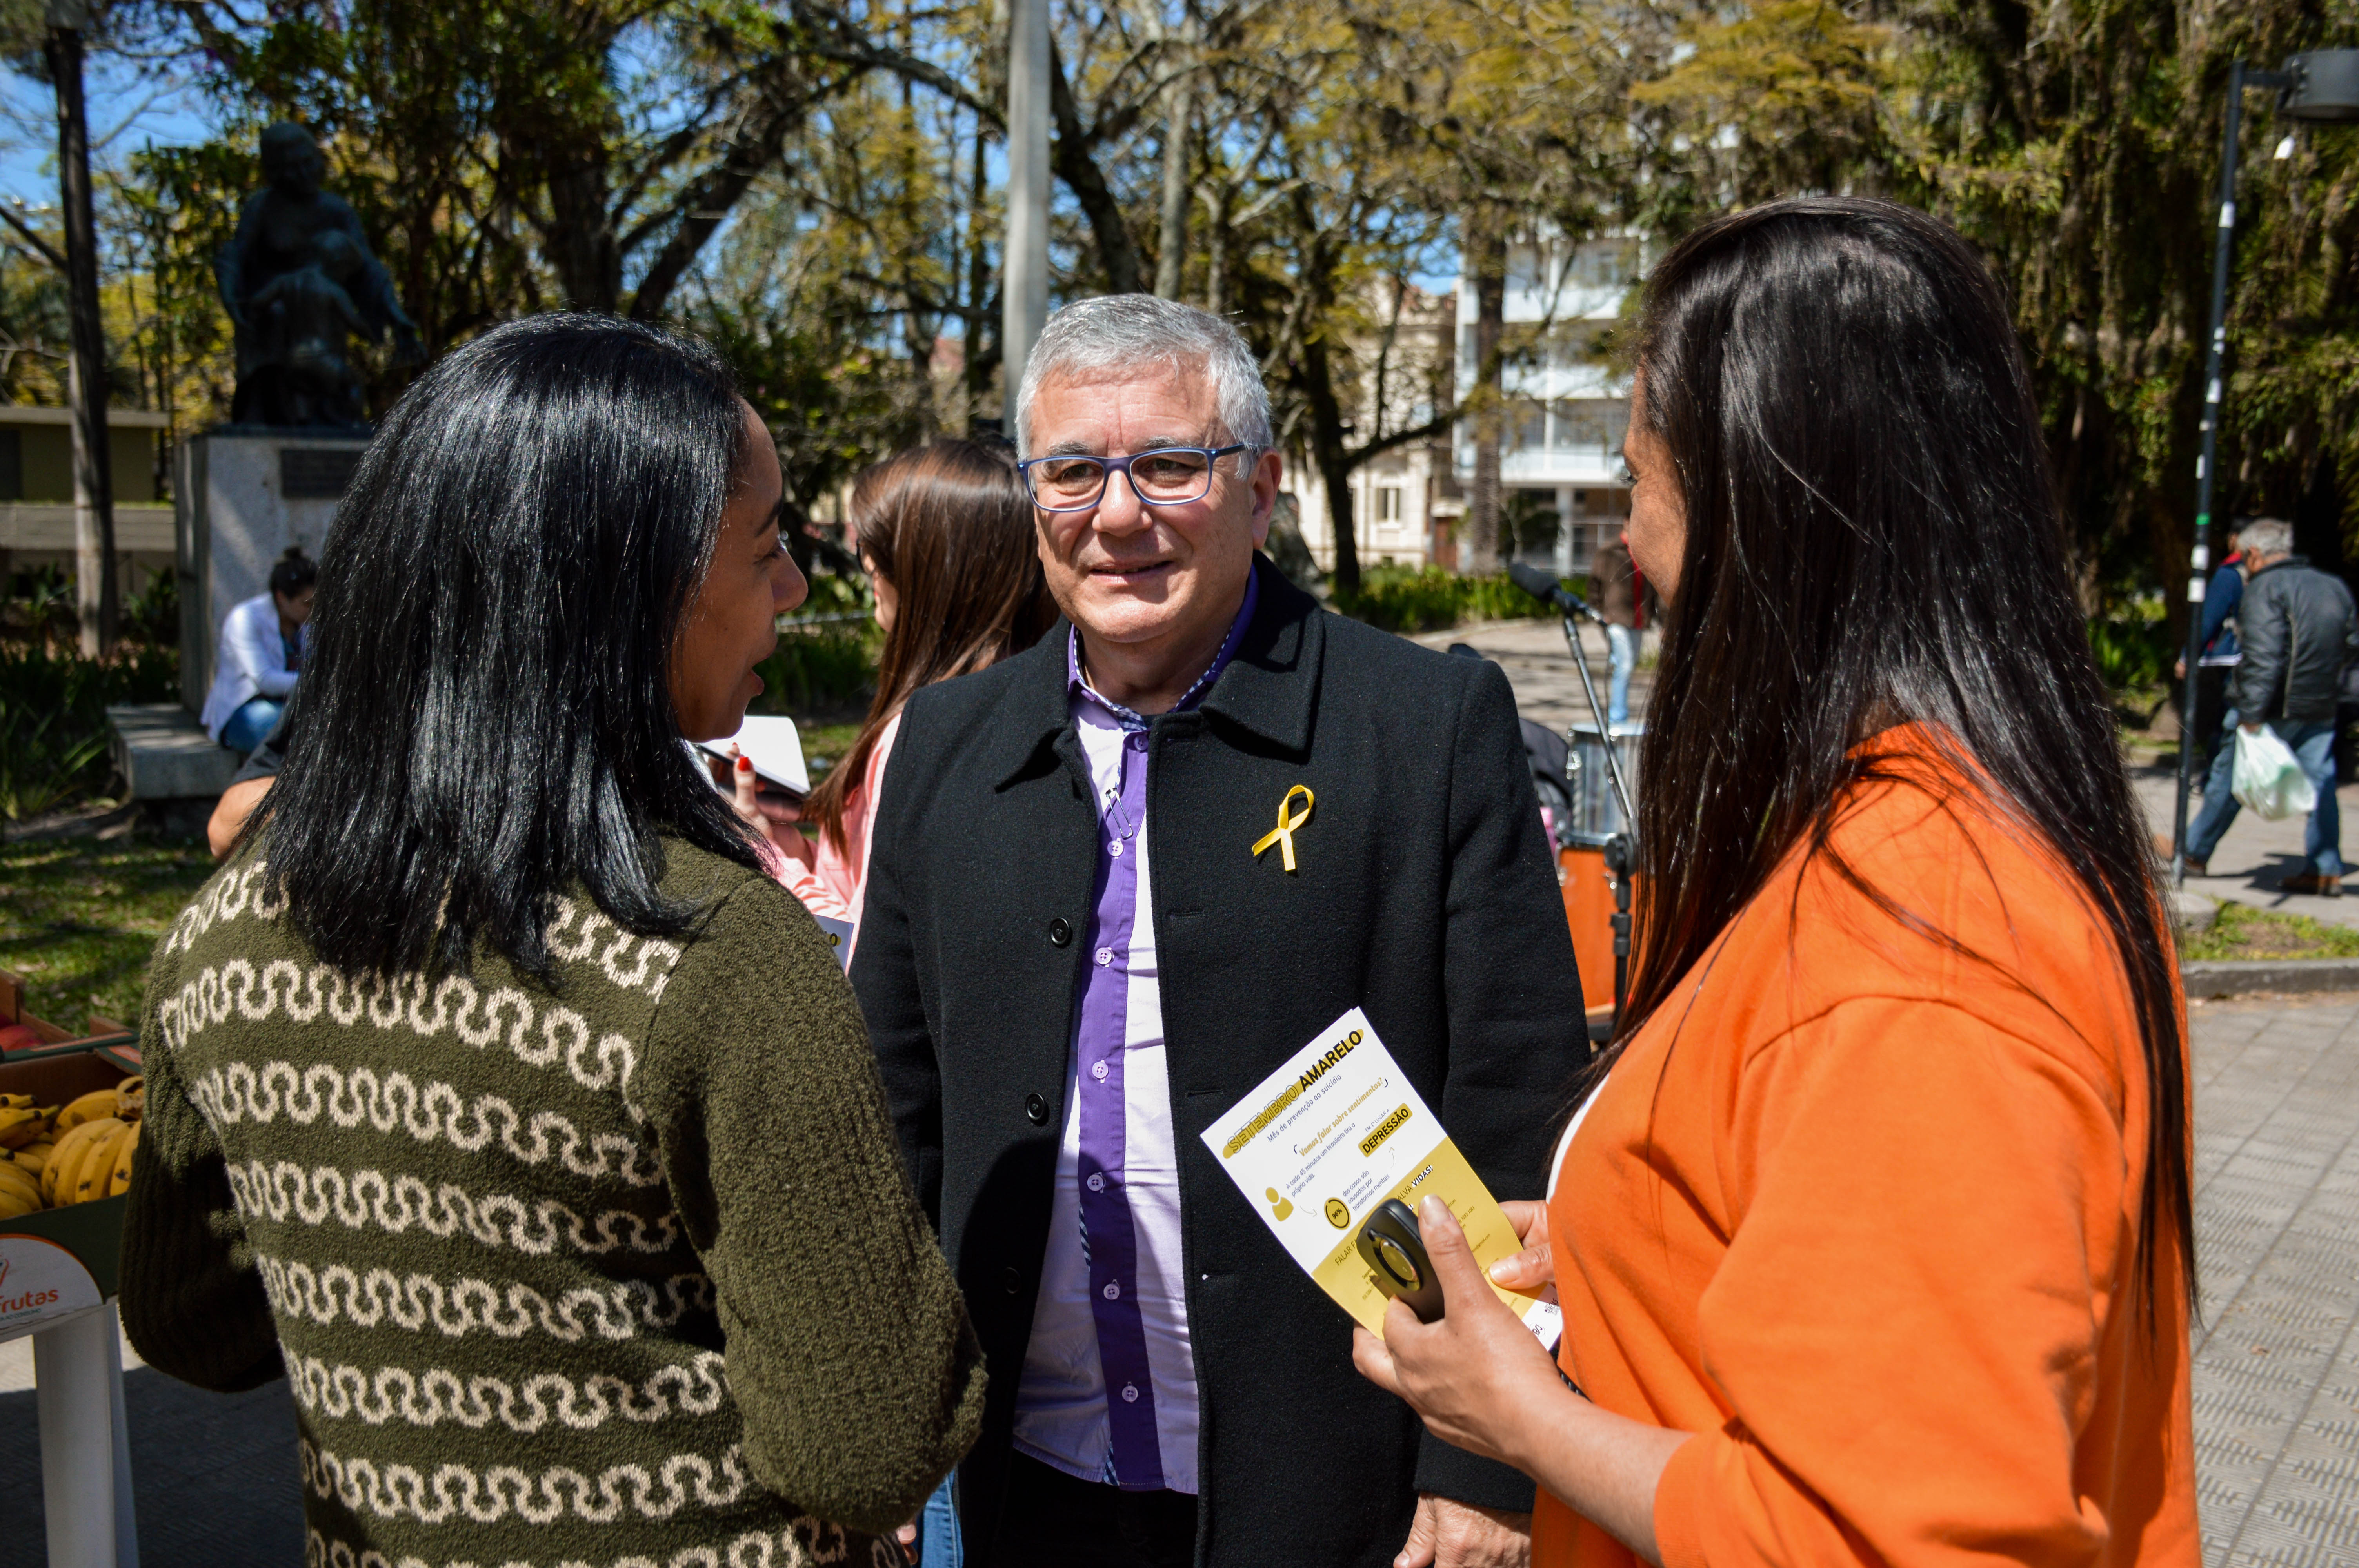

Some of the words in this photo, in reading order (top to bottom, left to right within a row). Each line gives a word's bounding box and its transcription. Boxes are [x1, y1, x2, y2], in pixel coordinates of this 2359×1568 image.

[1227, 1084, 1299, 1154] SETEMBRO
[1299, 1030, 1361, 1092] AMARELO
[1267, 1130, 1279, 1142] Mês
[1279, 1123, 1287, 1132] de
[1287, 1099, 1314, 1127] prevenção
[1313, 1092, 1321, 1101] ao
[1321, 1074, 1341, 1094] suicídio
[1299, 1138, 1319, 1157] Vamos
[1315, 1124, 1332, 1143] falar
[1331, 1110, 1348, 1127] sobre
[1347, 1076, 1383, 1113] sentimentos?
[1362, 1108, 1408, 1154] DEPRESSÃO
[1374, 1111, 1387, 1123] LUGAR
[1289, 1174, 1301, 1186] cada
[1299, 1167, 1306, 1176] 45
[1305, 1154, 1321, 1171] minutos
[1320, 1148, 1328, 1157] um
[1325, 1132, 1345, 1151] brasileiro
[1343, 1125, 1352, 1134] tira
[1291, 1181, 1306, 1198] própria
[1304, 1173, 1315, 1183] vida.
[1342, 1188, 1350, 1197] dos
[1349, 1177, 1361, 1190] casos
[1360, 1170, 1369, 1179] são
[1347, 1185, 1366, 1204] causados
[1352, 1189, 1374, 1211] transtornos
[1373, 1174, 1390, 1191] mentais
[1396, 1185, 1413, 1202] ALVA
[1410, 1164, 1433, 1187] VIDAS!
[1332, 1208, 1342, 1219] 96%
[1334, 1245, 1353, 1266] FALAR
